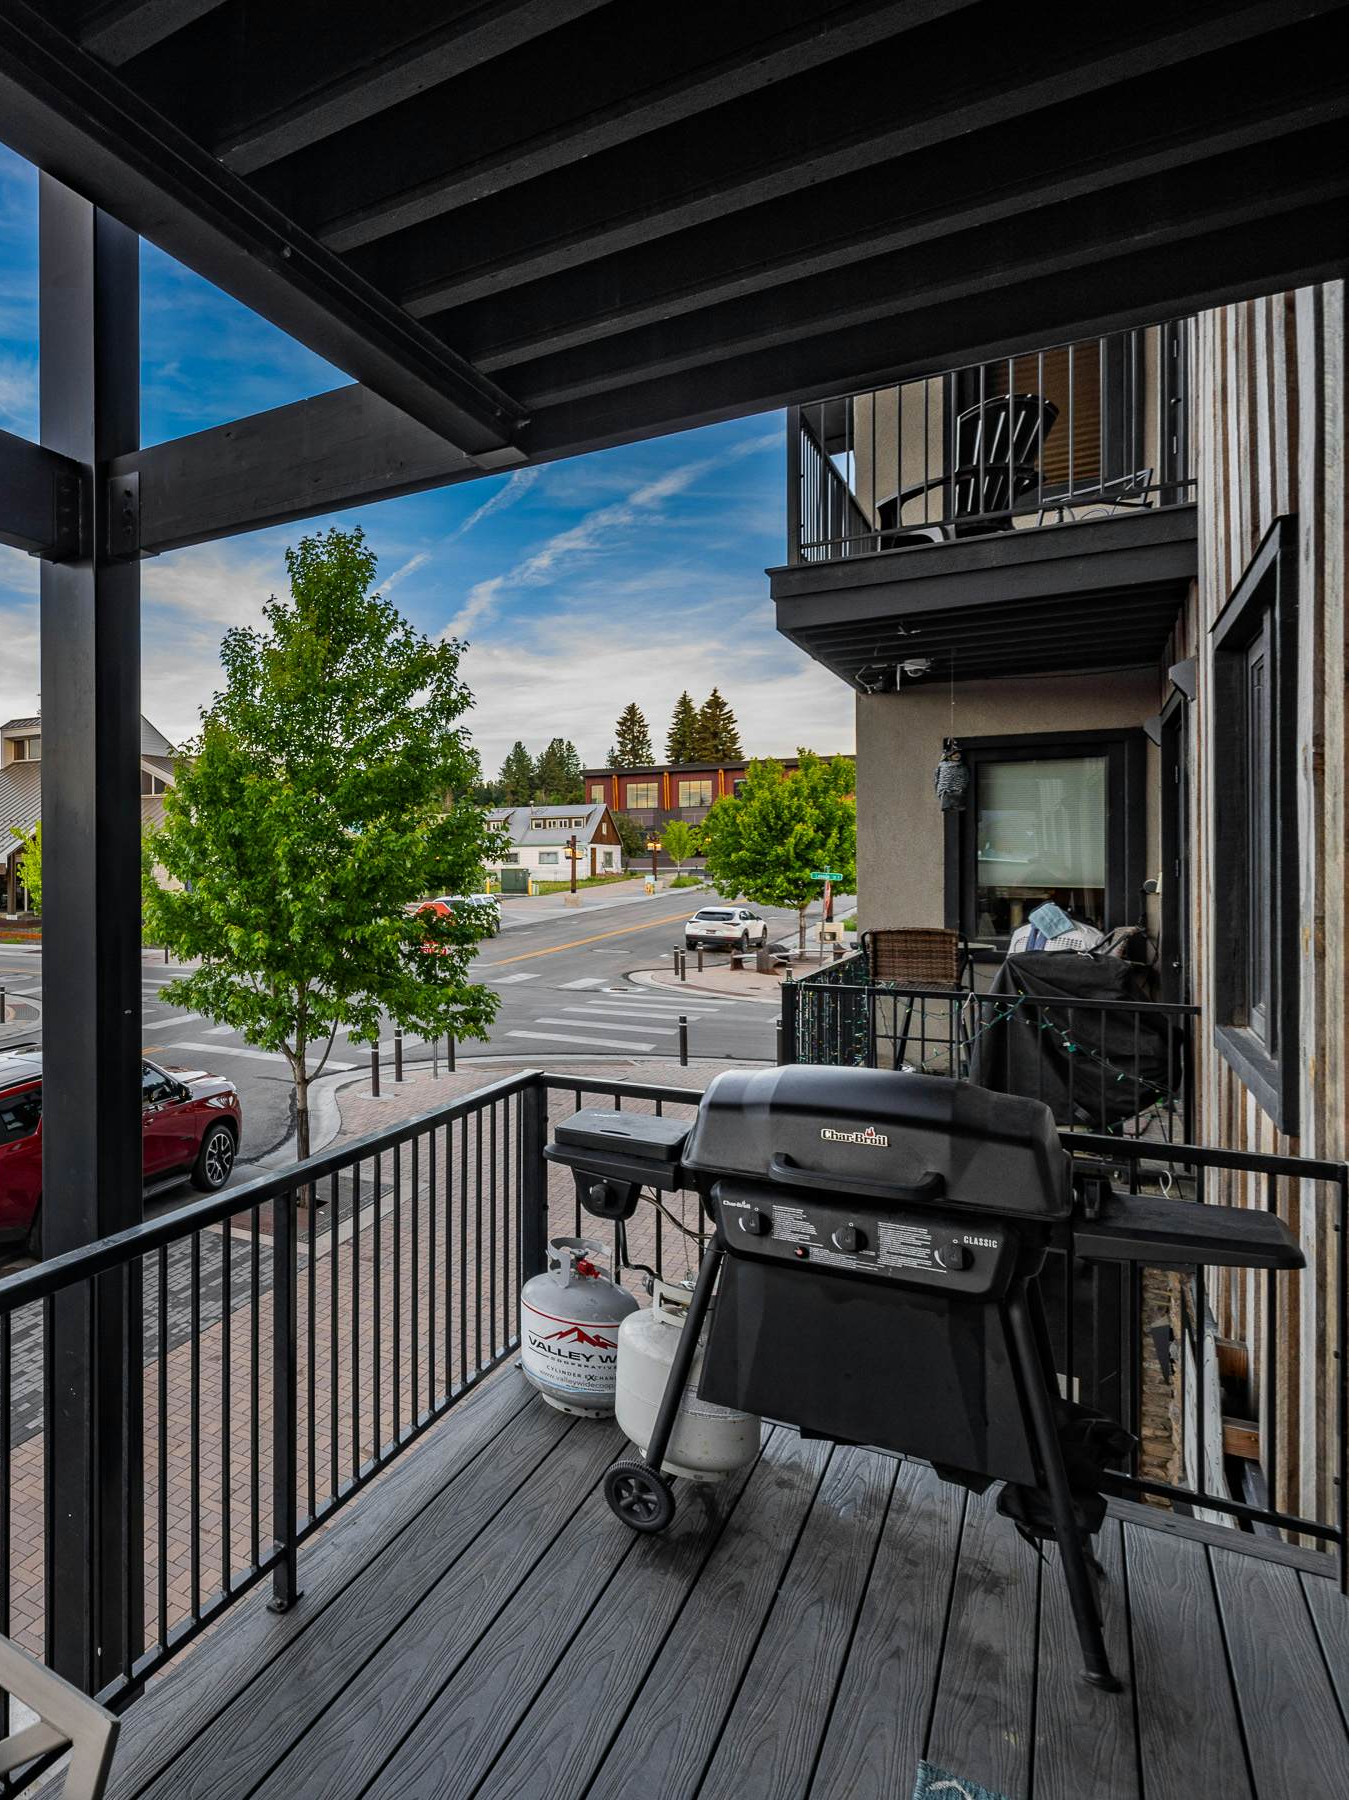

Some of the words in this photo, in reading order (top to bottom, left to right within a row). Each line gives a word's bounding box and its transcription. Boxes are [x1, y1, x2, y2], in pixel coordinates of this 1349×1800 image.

[820, 1128, 889, 1147] Char-Broil
[962, 1235, 999, 1249] CLASSIC
[528, 1334, 595, 1363] VALLEY
